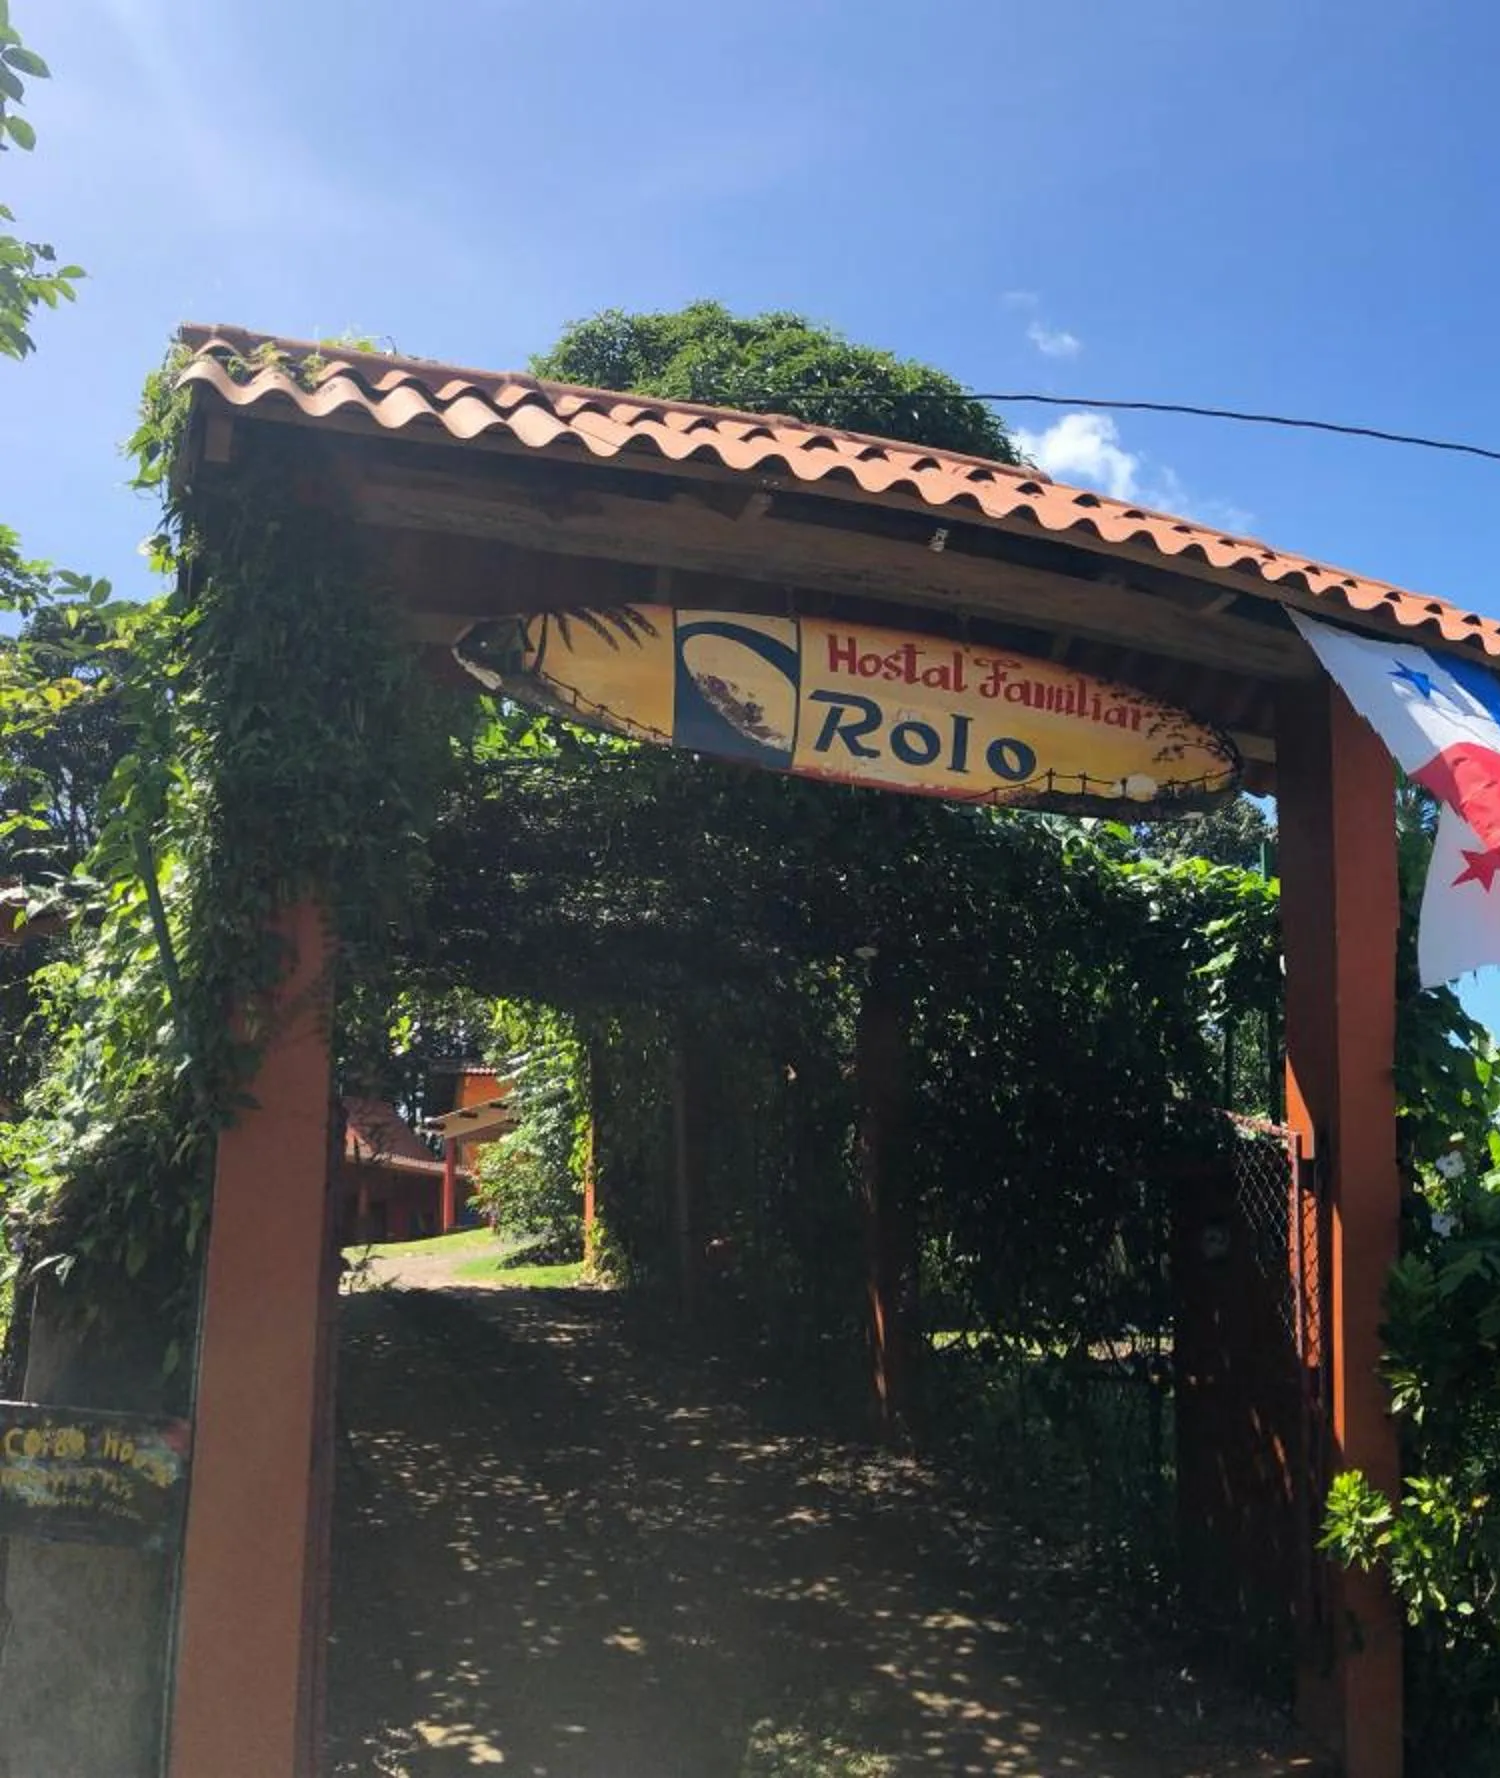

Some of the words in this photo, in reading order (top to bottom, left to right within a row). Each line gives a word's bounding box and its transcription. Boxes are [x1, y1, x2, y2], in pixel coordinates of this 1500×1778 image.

[826, 633, 969, 693] Hostal
[973, 657, 1156, 732] Familiar
[808, 688, 1037, 783] Rolo
